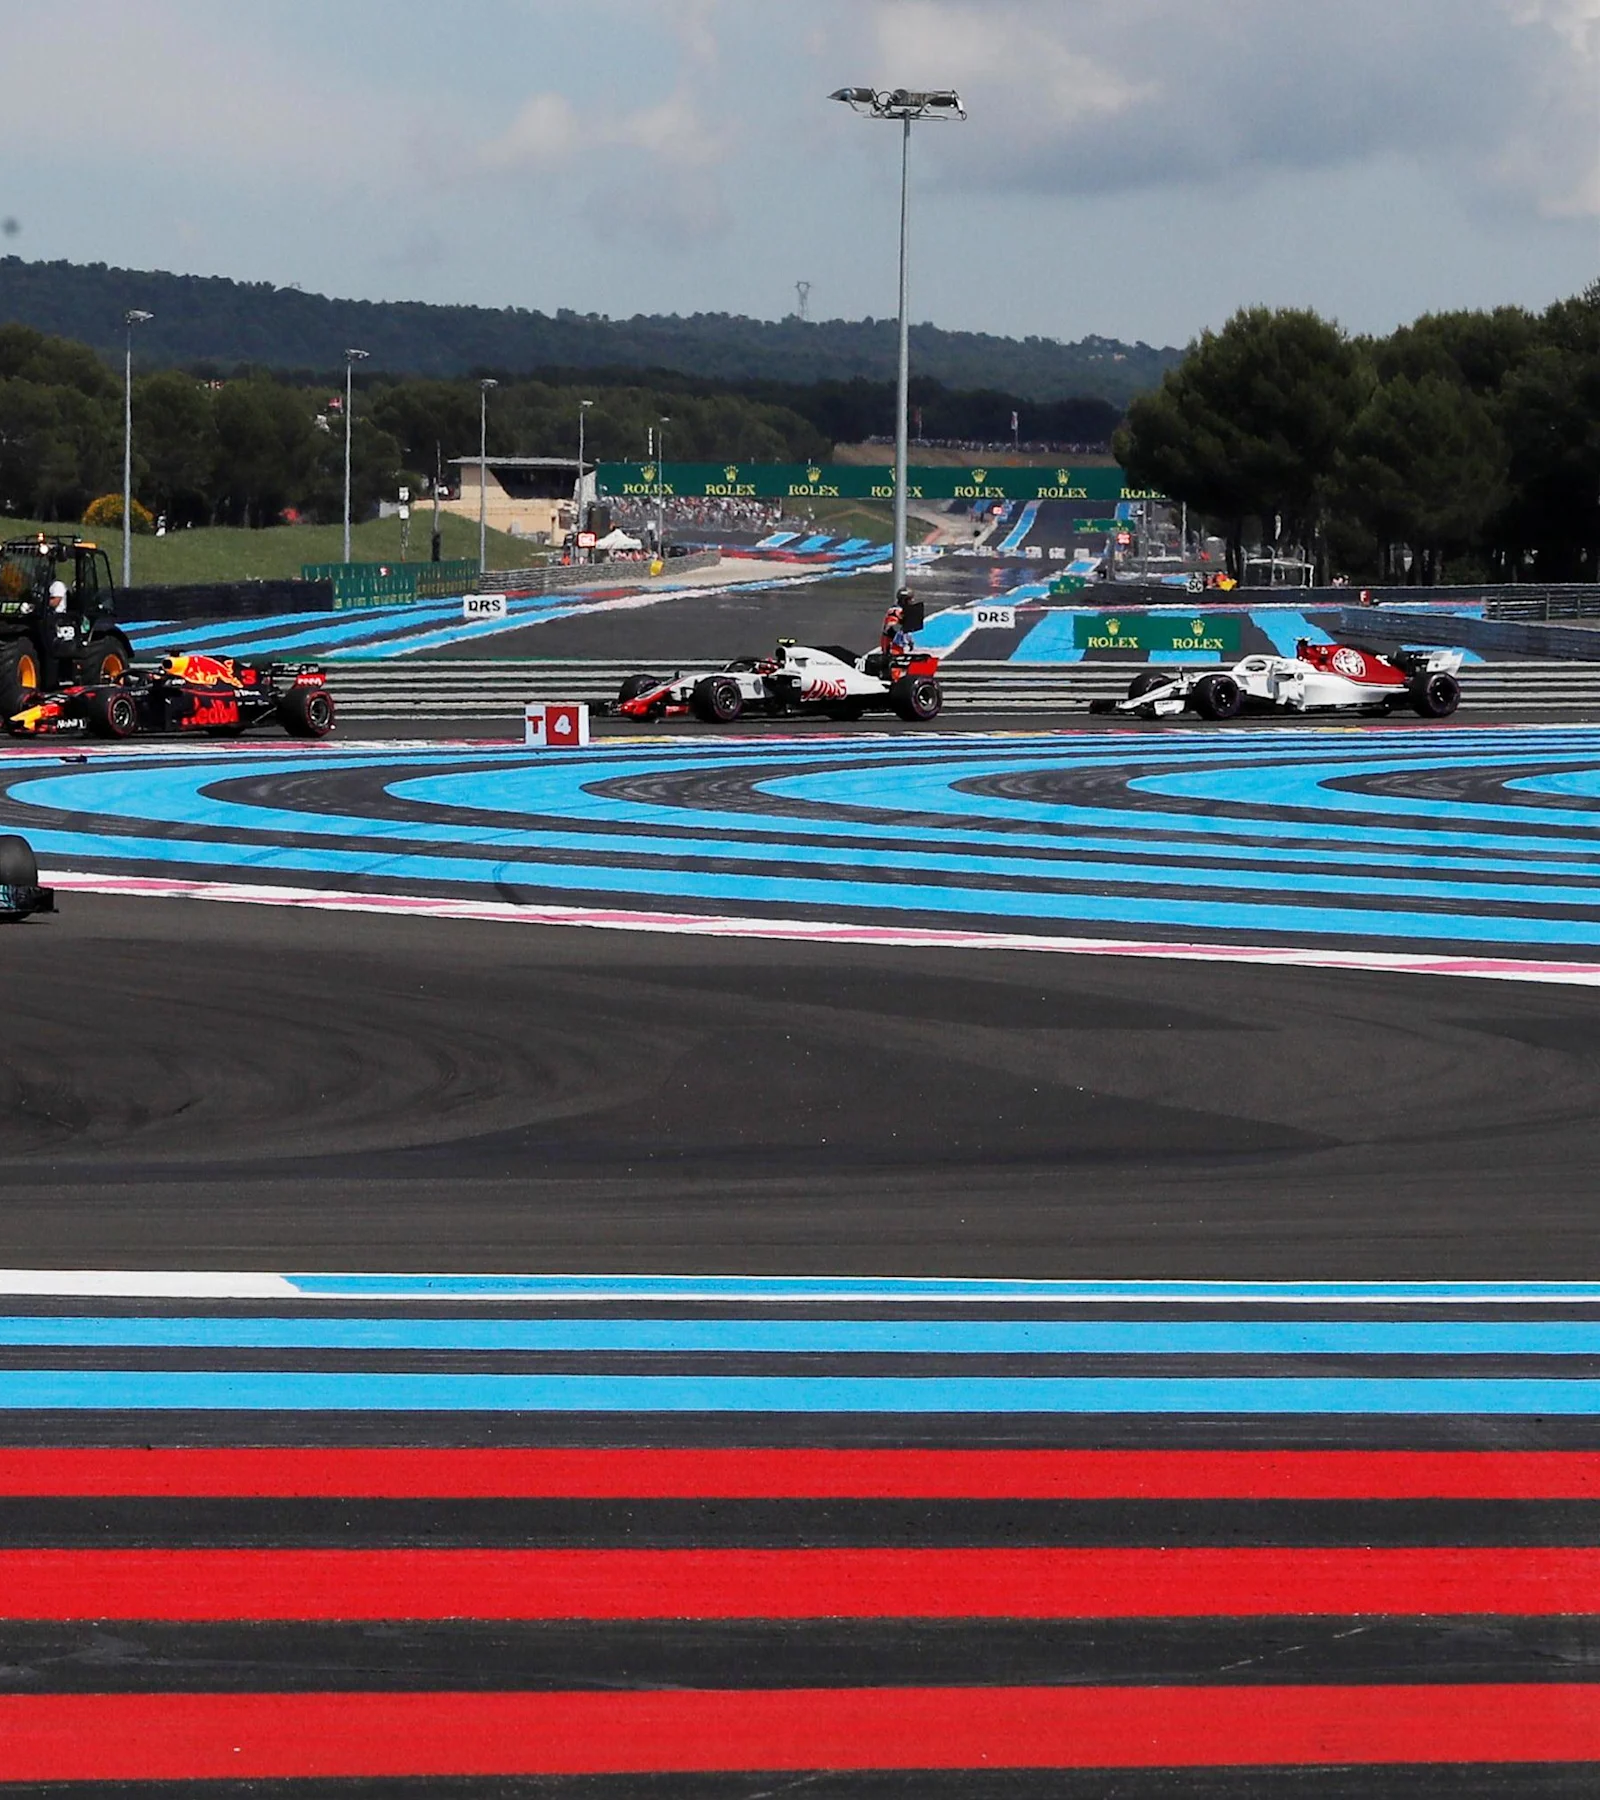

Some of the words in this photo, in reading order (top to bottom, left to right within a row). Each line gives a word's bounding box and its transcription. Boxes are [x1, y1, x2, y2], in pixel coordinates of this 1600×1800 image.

[623, 483, 674, 495] ROLEX
[705, 484, 756, 496] ROLEX
[788, 484, 839, 497] ROLEX
[871, 486, 922, 498] ROEX
[954, 486, 1005, 498] ROLEX
[1037, 487, 1087, 499] ROLEX
[1120, 487, 1166, 499] ROLE
[468, 600, 501, 612] DRS
[978, 611, 1009, 623] DRS
[1088, 636, 1138, 649] ROLEX
[1173, 637, 1223, 650] ROLEX
[241, 669, 256, 685] 3
